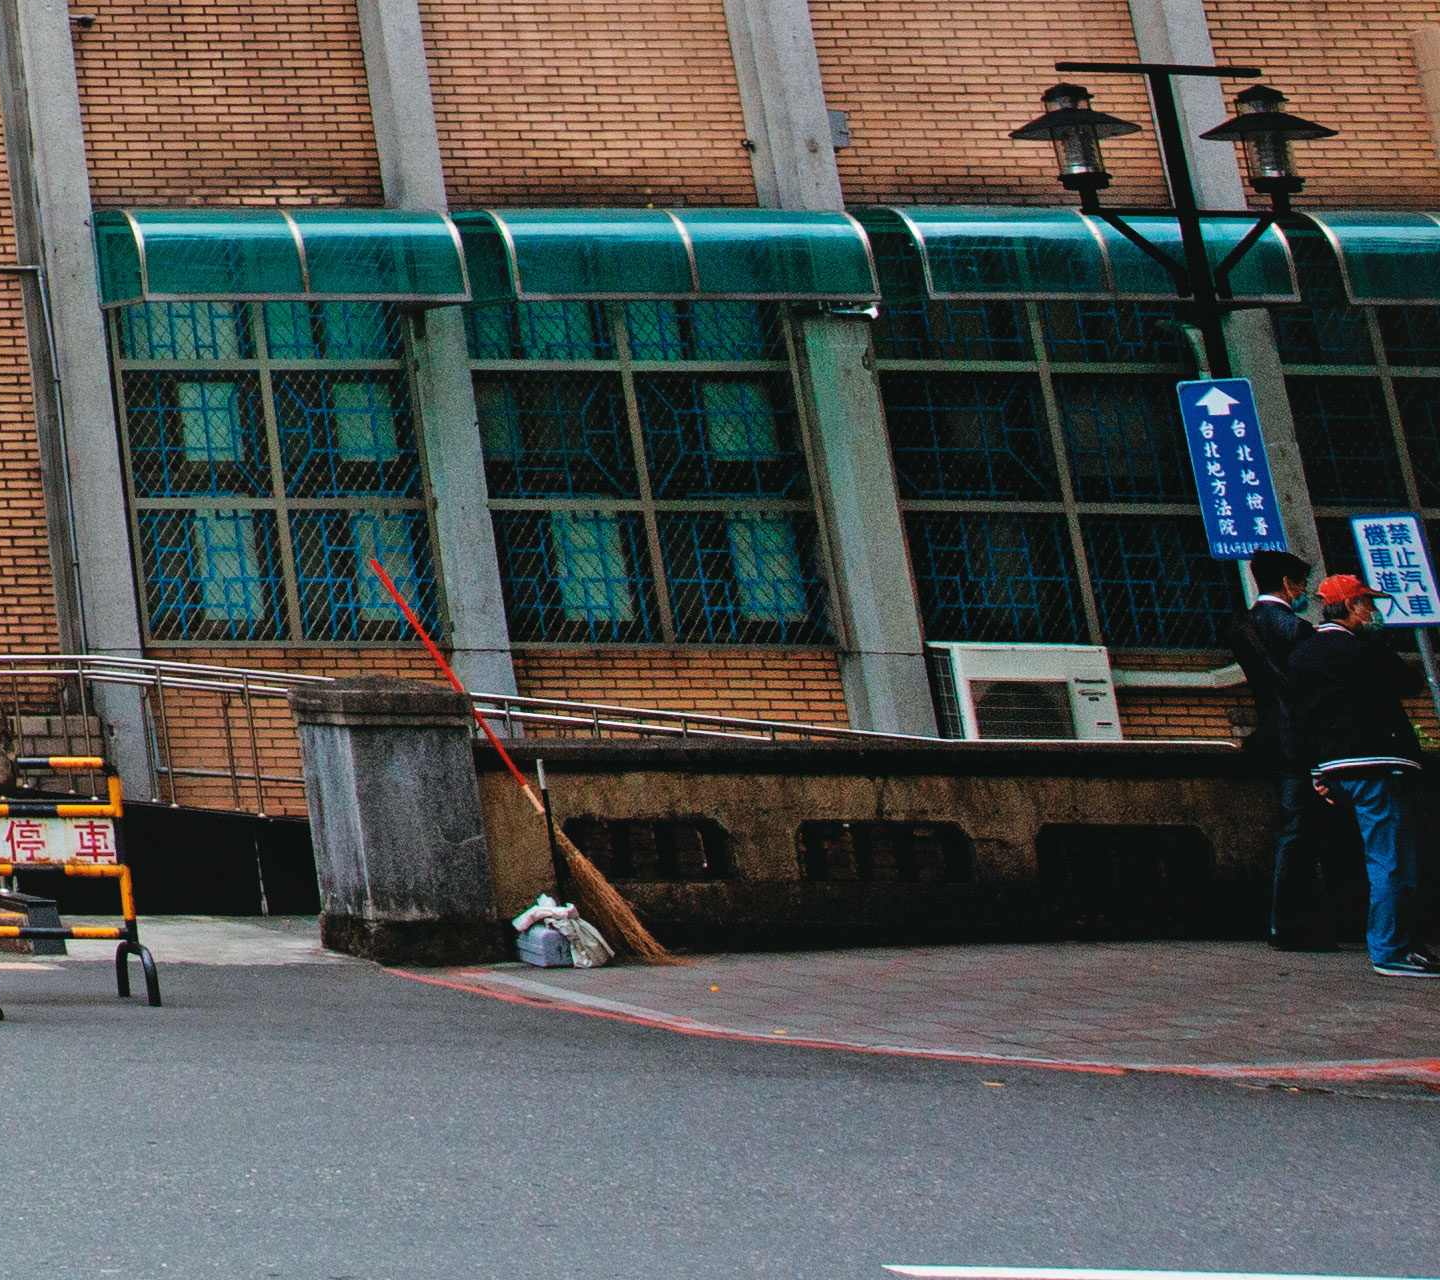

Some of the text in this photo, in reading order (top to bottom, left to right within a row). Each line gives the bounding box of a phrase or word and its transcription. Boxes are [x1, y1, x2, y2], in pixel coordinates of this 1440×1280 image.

[1198, 420, 1238, 536] 台北地方法院
[1231, 419, 1268, 536] 台北地檢署
[1363, 523, 1409, 617] 機車進入
[1386, 523, 1434, 616] 禁止汽車
